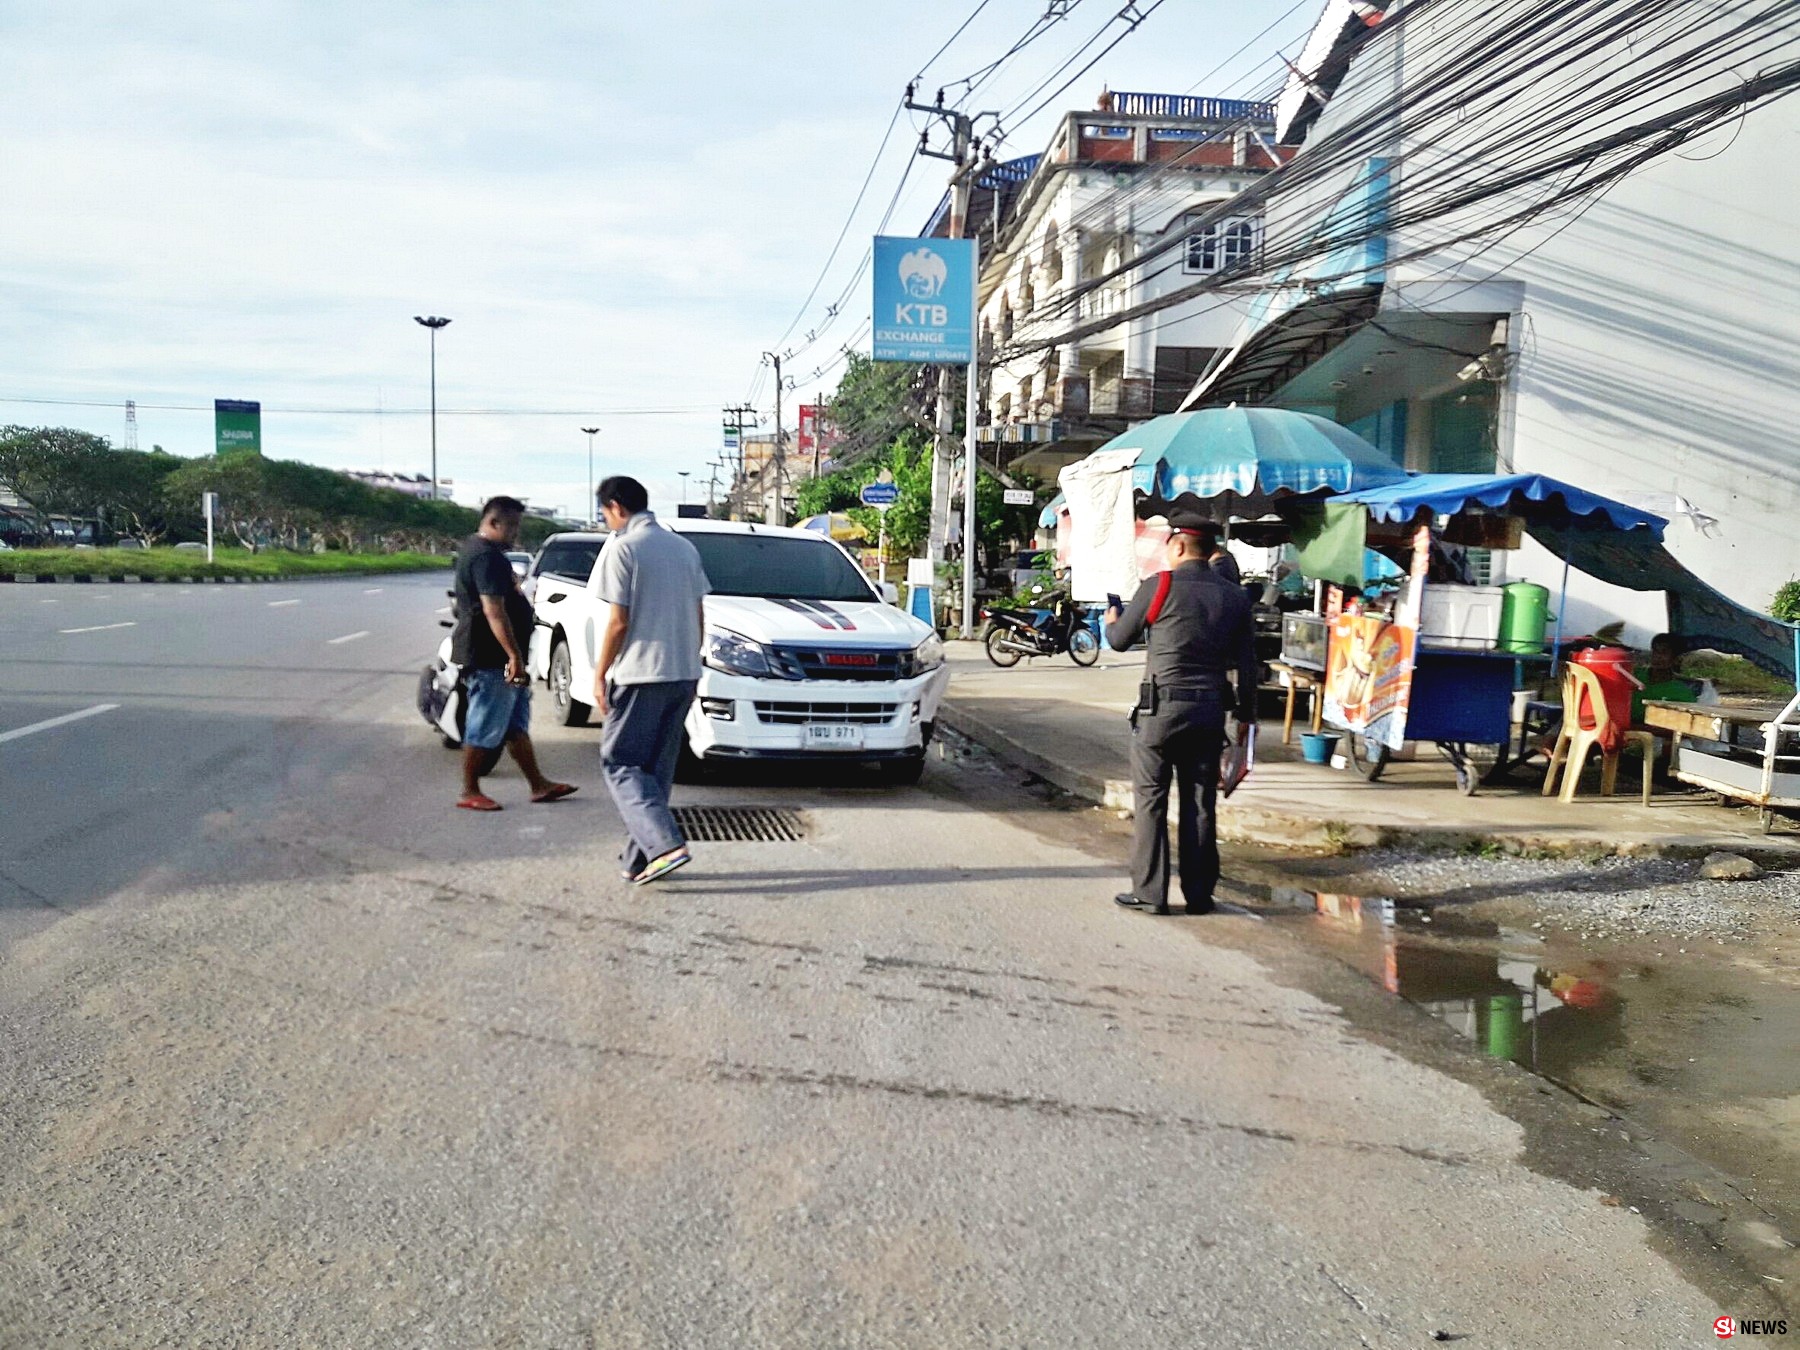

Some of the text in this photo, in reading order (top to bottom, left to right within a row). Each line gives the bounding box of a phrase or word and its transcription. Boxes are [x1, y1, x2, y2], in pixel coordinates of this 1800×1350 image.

[895, 303, 948, 327] KTB
[876, 330, 945, 343] EXCHANGE
[826, 654, 878, 666] ISUZU
[835, 726, 855, 738] 971
